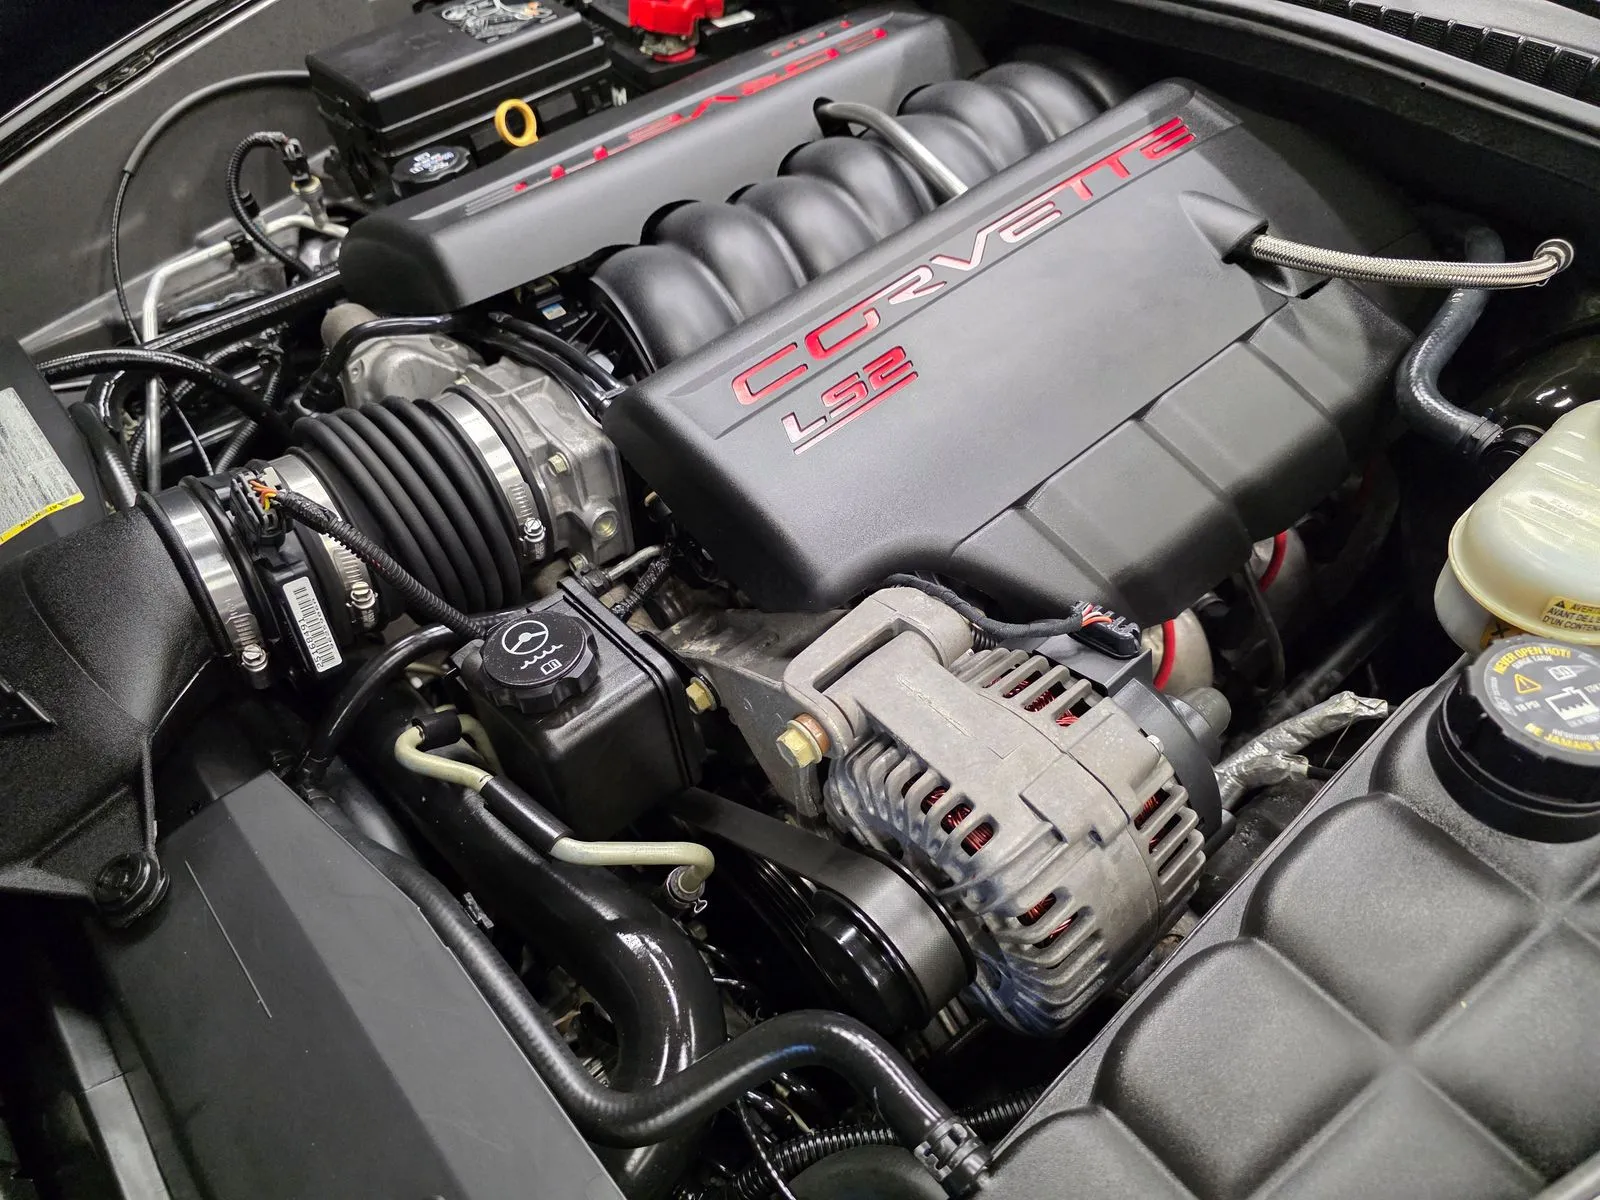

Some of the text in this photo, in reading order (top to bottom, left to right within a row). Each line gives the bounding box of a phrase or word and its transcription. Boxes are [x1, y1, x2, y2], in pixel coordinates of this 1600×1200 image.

[731, 117, 1196, 406] CORVETTE
[781, 345, 918, 445] LS2
[298, 618, 324, 668] 25168491
[1493, 651, 1517, 675] NEVER
[1514, 646, 1543, 659] OPEN
